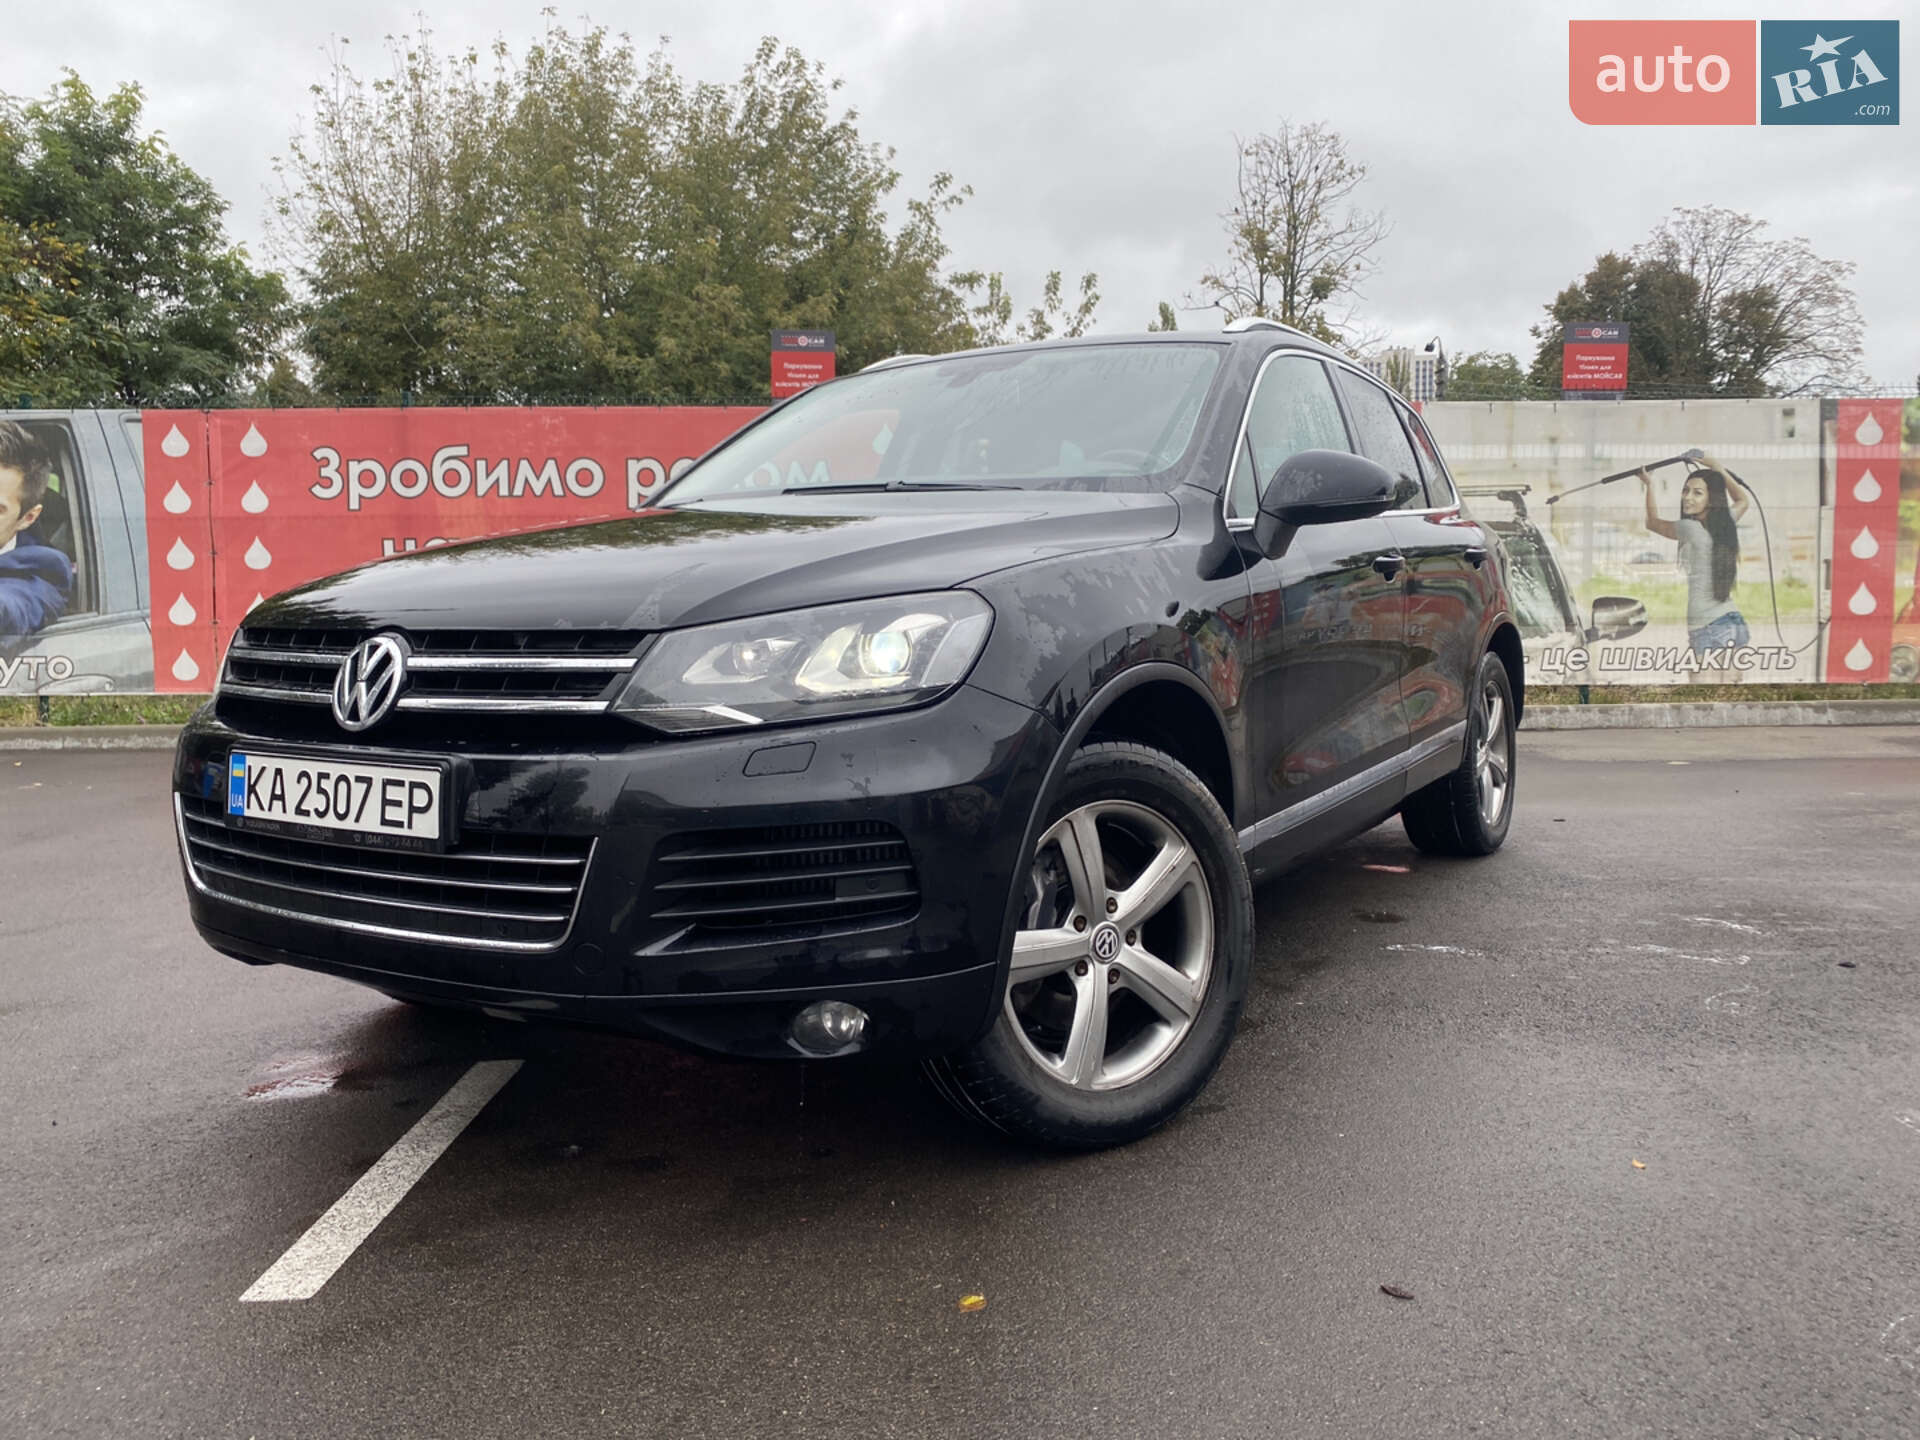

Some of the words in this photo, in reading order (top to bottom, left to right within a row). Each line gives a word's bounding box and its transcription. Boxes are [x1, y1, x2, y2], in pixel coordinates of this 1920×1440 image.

[309, 443, 605, 511] Зробимо
[1540, 646, 1590, 675] це
[1599, 639, 1797, 673] швидкість
[231, 793, 244, 809] UA
[246, 764, 287, 814] KA
[294, 770, 373, 823] 2507
[380, 778, 434, 830] EP
